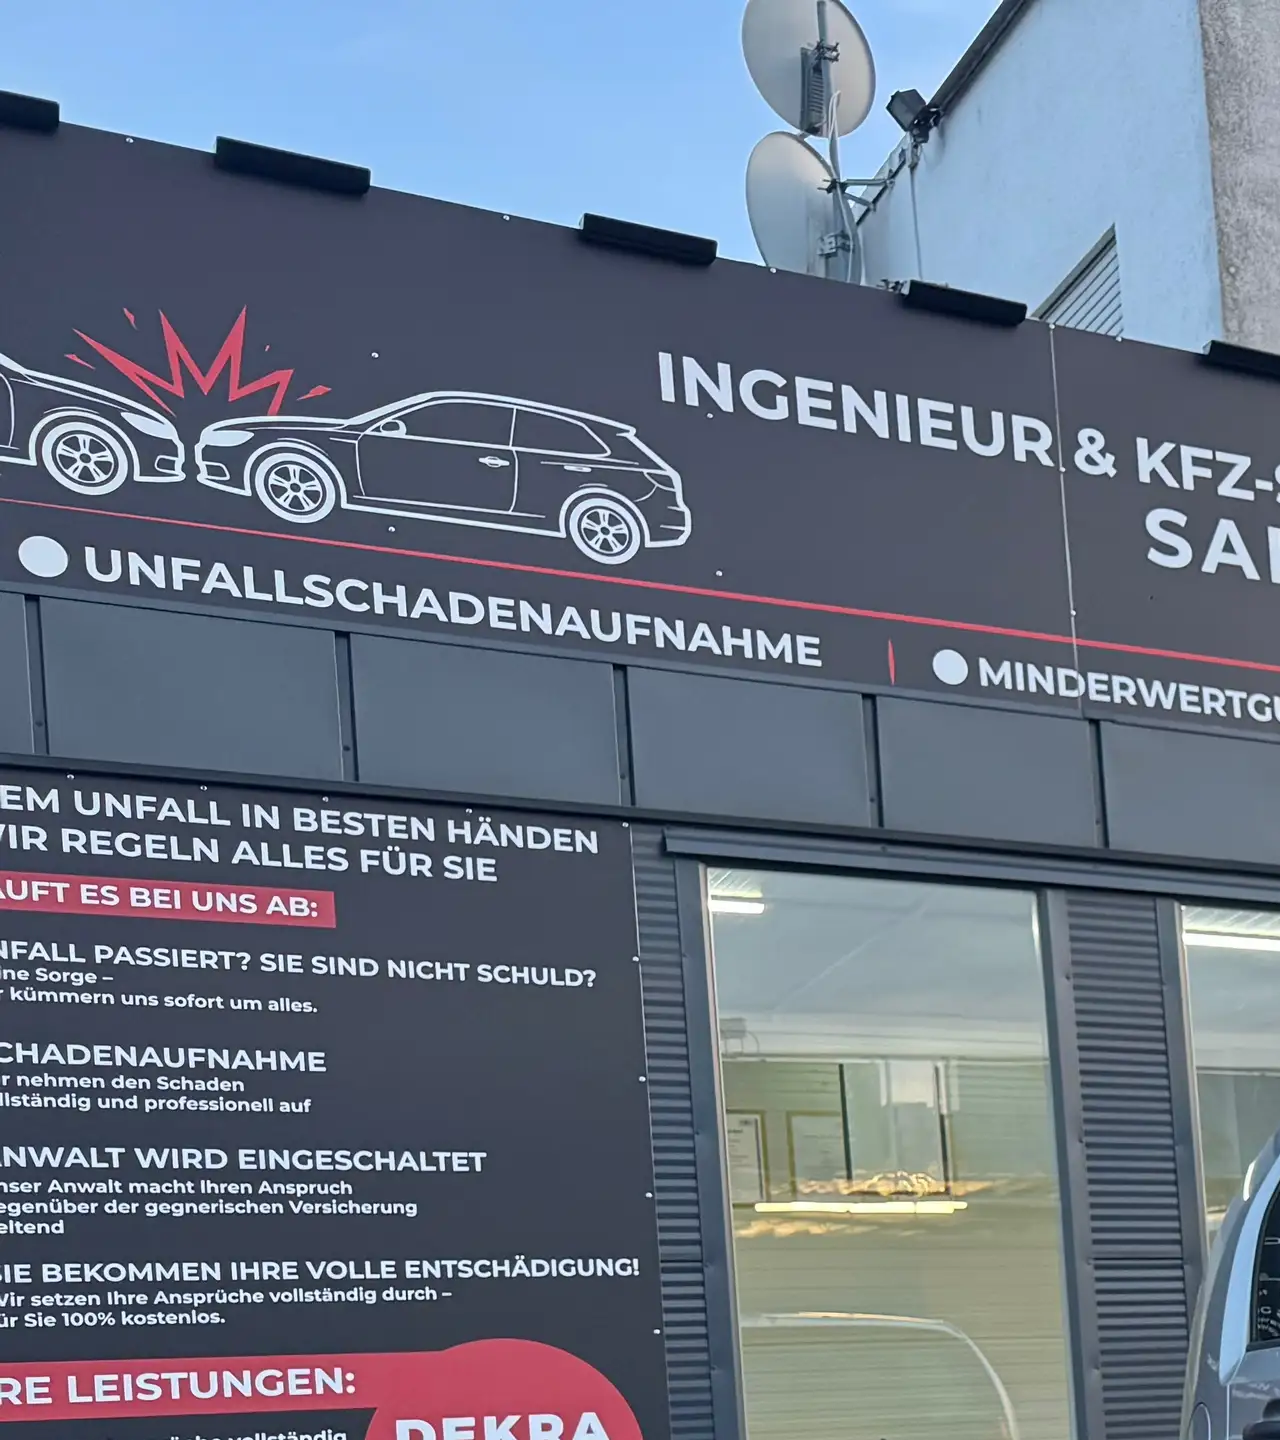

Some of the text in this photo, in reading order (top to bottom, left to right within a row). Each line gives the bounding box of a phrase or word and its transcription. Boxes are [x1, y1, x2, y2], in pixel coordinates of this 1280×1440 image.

[657, 351, 1054, 468] INGENIEUR
[1074, 428, 1117, 478] &
[84, 545, 823, 668] UNFALLSCHADENAUFNAHME
[74, 791, 230, 825] UNFALL
[242, 804, 279, 829] IN
[294, 808, 434, 841] BESTEN
[448, 817, 598, 853] HÄNDEN
[62, 828, 219, 862] REGELN
[232, 841, 348, 871] ALLES
[360, 846, 432, 877] FÜR
[444, 856, 497, 881] SIE
[0, 879, 317, 917] UFT ES BEI UNS AB:
[36, 968, 97, 986] Sorge
[95, 945, 250, 970] PASSIERT?
[260, 953, 303, 973] SIE
[312, 956, 378, 976] SIND
[388, 960, 470, 981] NICHT
[477, 964, 596, 987] SCHULD?
[10, 987, 114, 1004] kümmern
[121, 994, 158, 1006] uns
[164, 994, 224, 1008] sofort
[230, 999, 262, 1010] um
[268, 998, 317, 1012] alles.
[17, 1073, 105, 1088] nehmen
[112, 1075, 150, 1089] den
[157, 1076, 244, 1091] Schaden
[98, 1095, 137, 1109] und
[145, 1096, 273, 1112] professionell
[280, 1099, 311, 1112] auf
[0, 1147, 487, 1171] NWALT WIRD EINGESCHALTET
[48, 1179, 122, 1193] Anwalt
[129, 1180, 195, 1193] macht
[201, 1180, 252, 1194] Ihren
[258, 1181, 352, 1197] Anspruch
[104, 1200, 139, 1213] der
[145, 1199, 283, 1216] gegnerischen
[289, 1199, 417, 1217] Versicherung
[0, 1255, 639, 1284] IE BEKOMMEN IHRE VOLLE ENTSCHÄDIGUNG!
[31, 1293, 100, 1306] setzen
[108, 1291, 148, 1305] Ihre
[154, 1289, 264, 1307] Ansprüche
[269, 1287, 376, 1304] vollständig
[382, 1287, 437, 1301] durch
[24, 1312, 56, 1327] Sie
[62, 1312, 115, 1326] 100%
[122, 1310, 225, 1325] kostenlos.
[68, 1368, 355, 1402] LEISTUNGEN:
